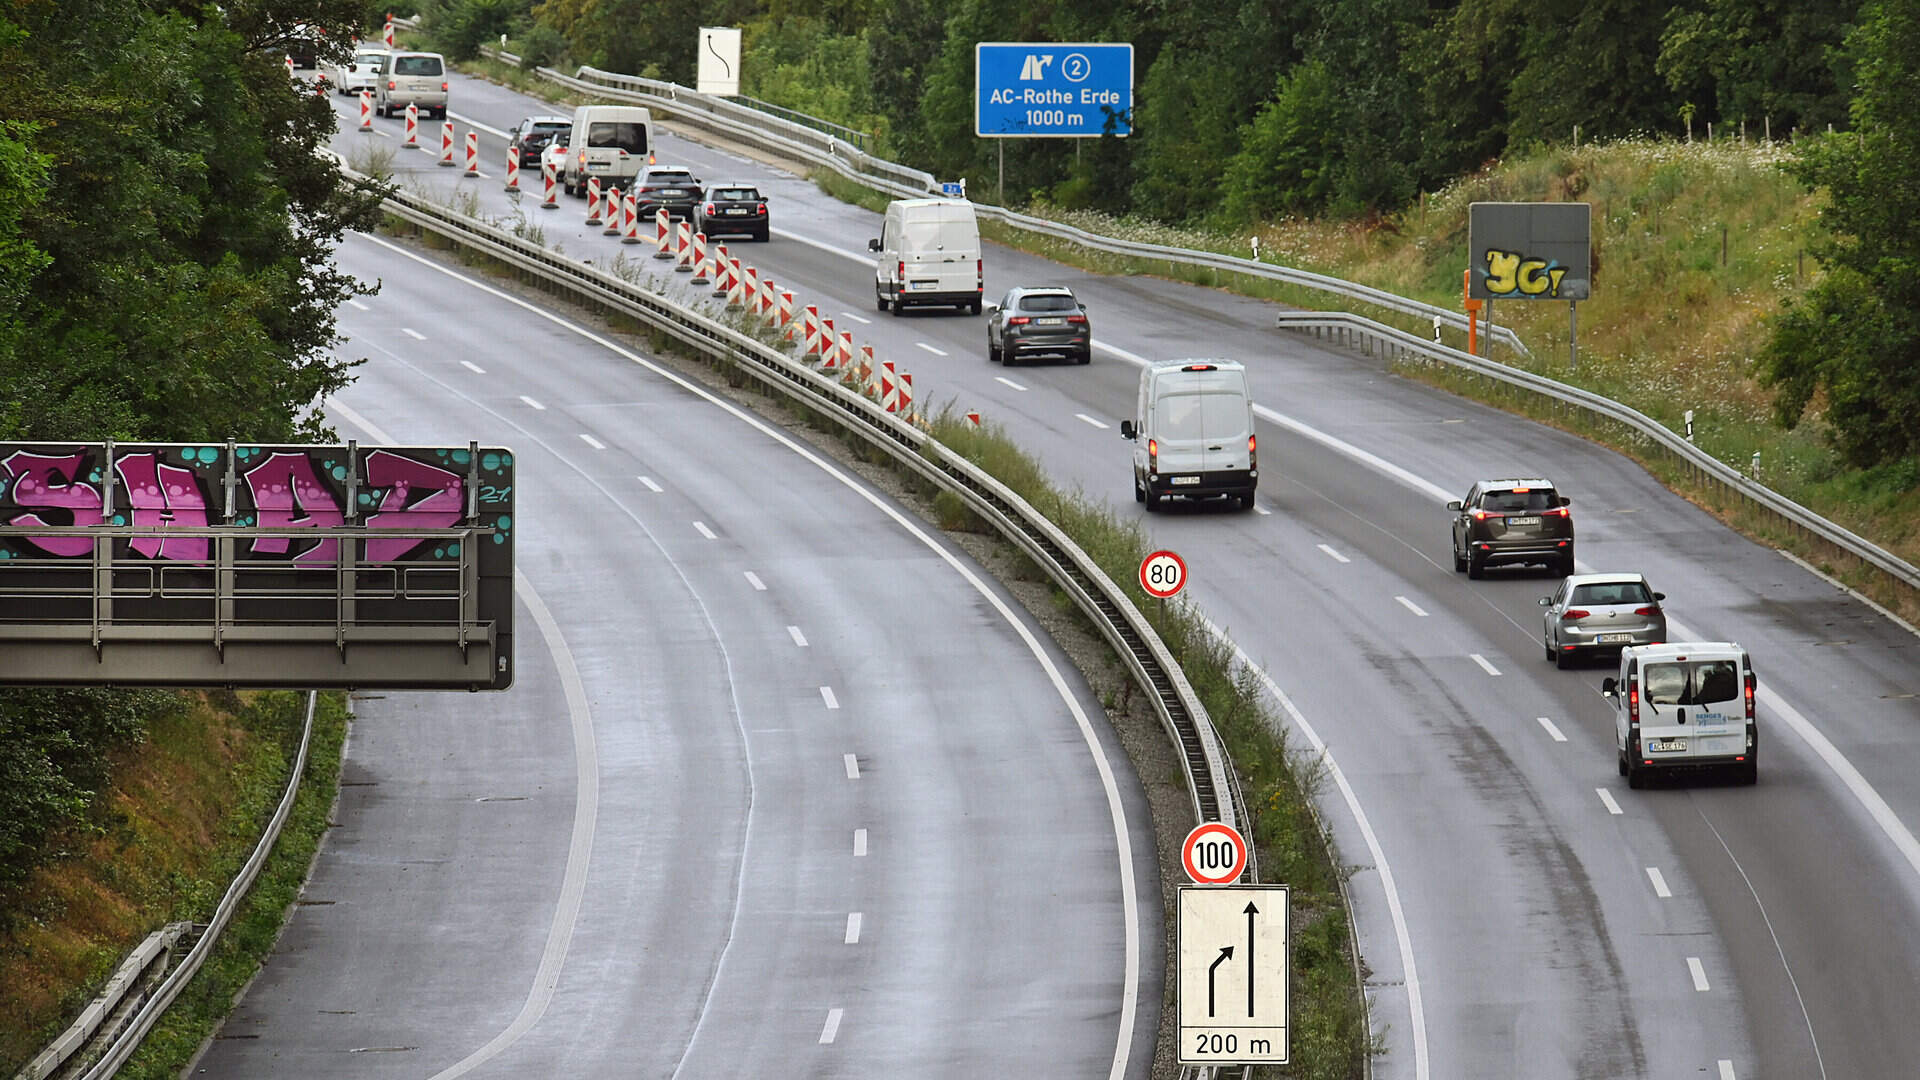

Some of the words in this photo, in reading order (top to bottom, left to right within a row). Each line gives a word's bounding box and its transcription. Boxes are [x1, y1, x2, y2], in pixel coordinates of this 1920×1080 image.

[1071, 60, 1081, 76] 2
[990, 88, 1073, 104] AC-Rothe
[1080, 88, 1120, 104] Erde
[1026, 110, 1064, 126] 1000
[1067, 113, 1083, 126] m
[1151, 564, 1176, 584] 80
[1196, 841, 1233, 869] 100
[1196, 1034, 1237, 1053] 200
[1250, 1039, 1270, 1053] m
